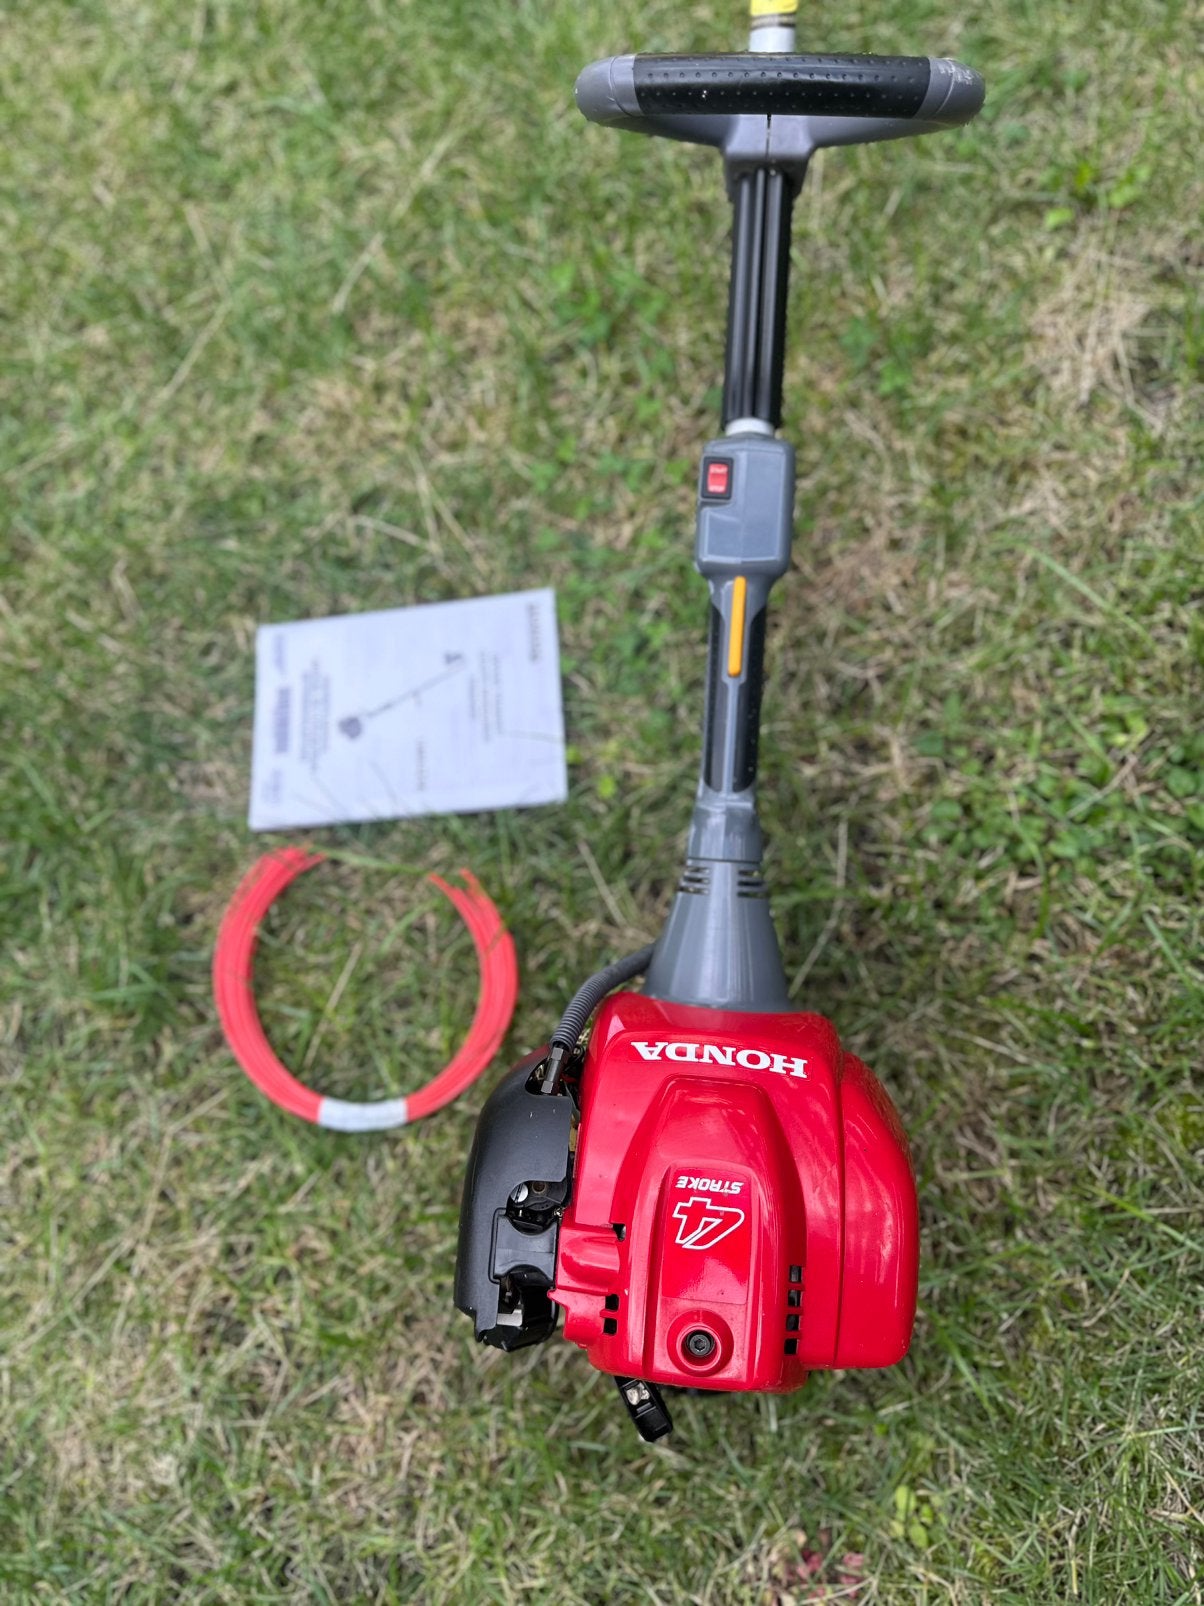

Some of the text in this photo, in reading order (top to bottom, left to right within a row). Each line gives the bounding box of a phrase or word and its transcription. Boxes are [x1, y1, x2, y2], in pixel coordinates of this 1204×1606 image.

[631, 1041, 808, 1079] HONDA
[675, 1175, 745, 1195] STROKE
[672, 1196, 746, 1251] 4
